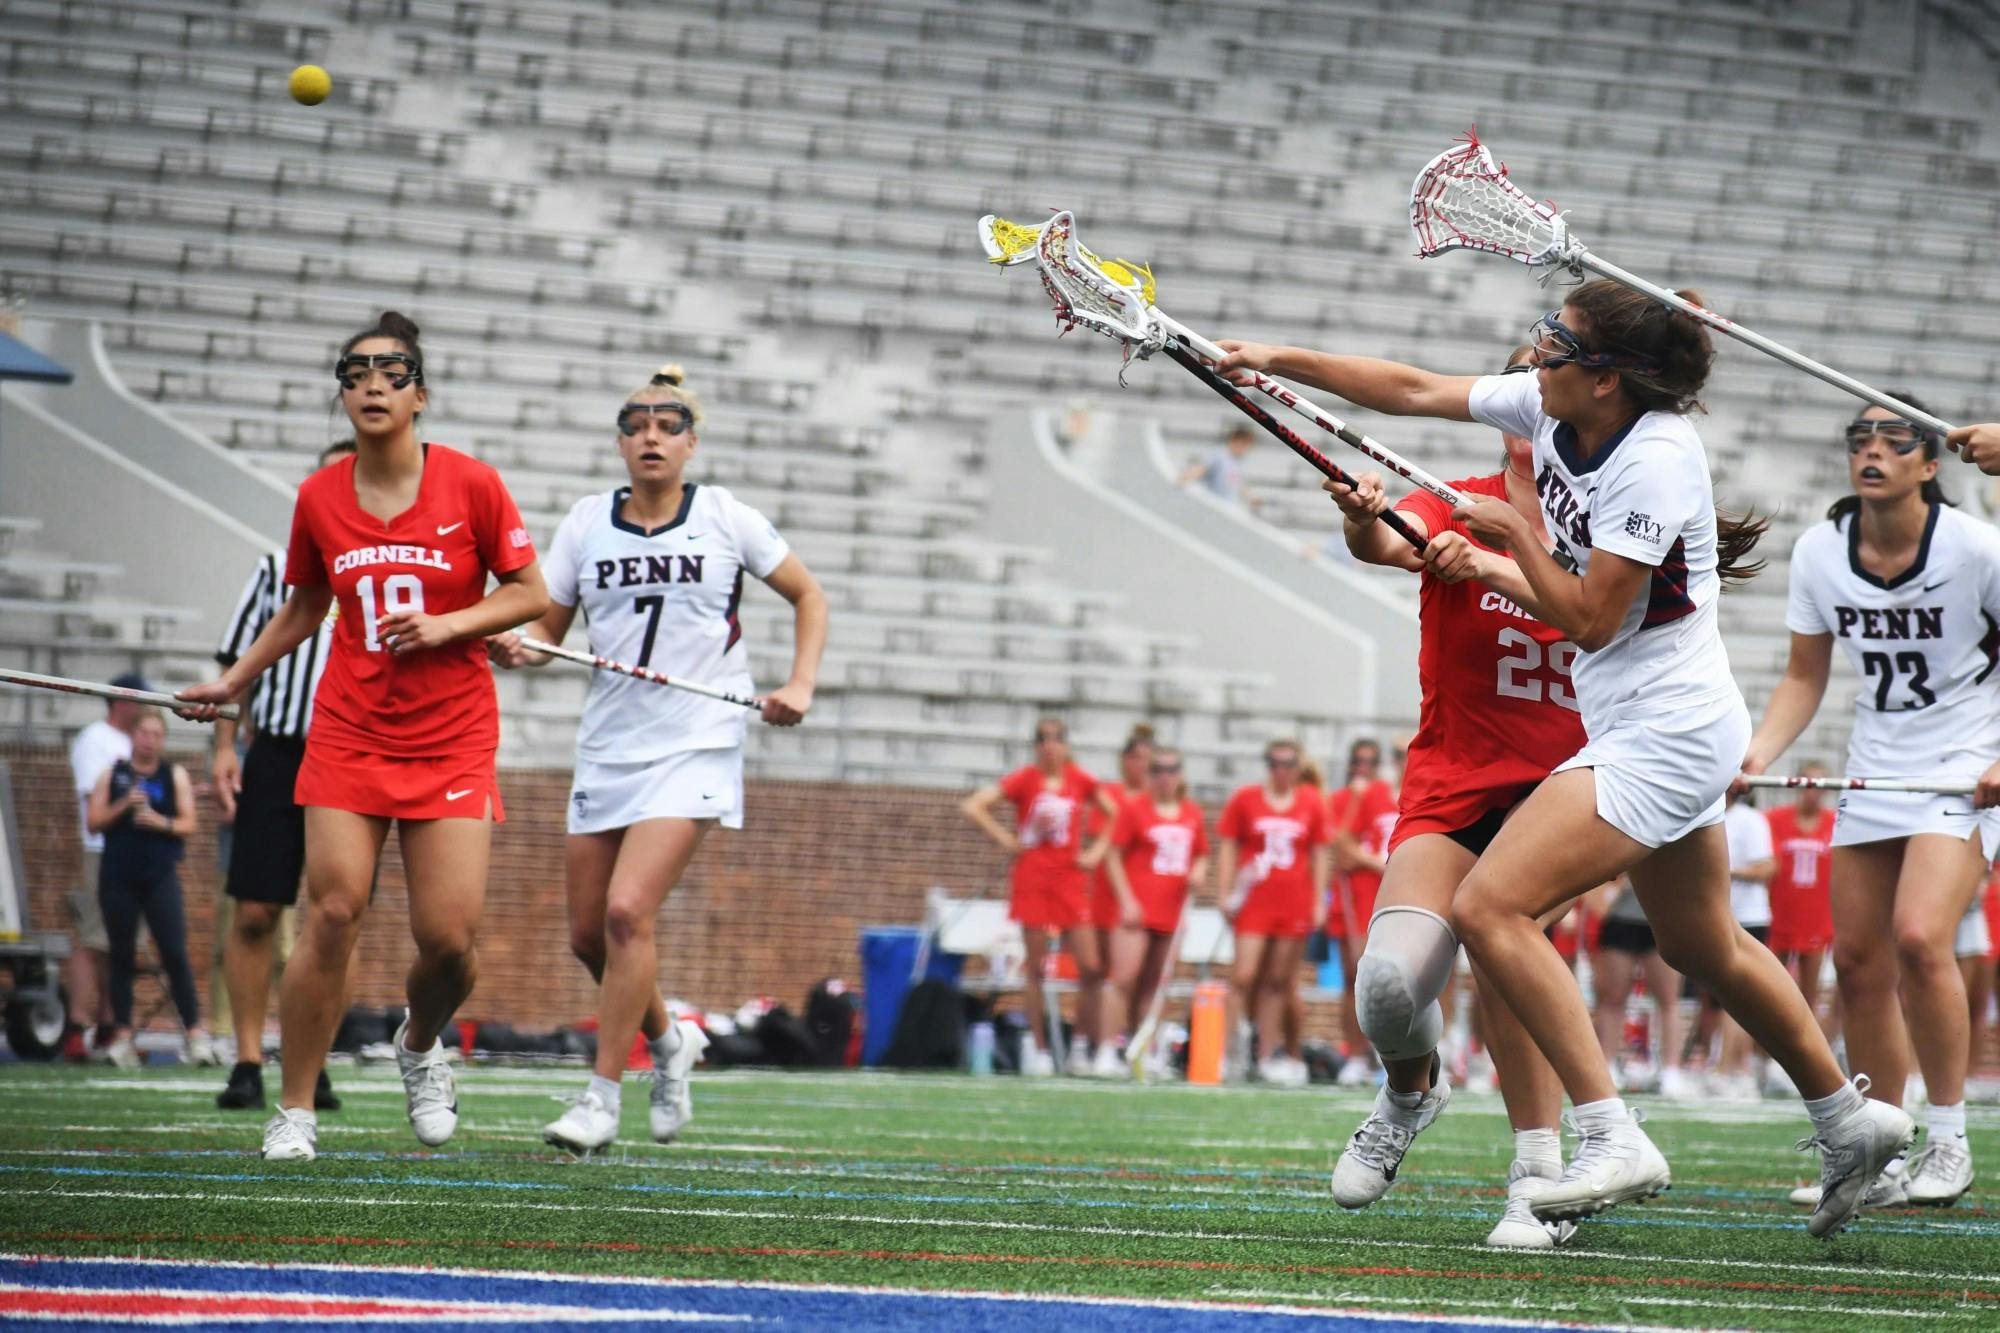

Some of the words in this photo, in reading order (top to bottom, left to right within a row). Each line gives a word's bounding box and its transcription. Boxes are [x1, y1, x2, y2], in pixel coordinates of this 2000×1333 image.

[1632, 530, 1662, 545] LEAGUE
[1634, 518, 1666, 538] IVY
[334, 545, 452, 575] CORNELL
[596, 555, 706, 589] PENN
[634, 594, 665, 667] 7
[1834, 606, 1944, 640] PENN
